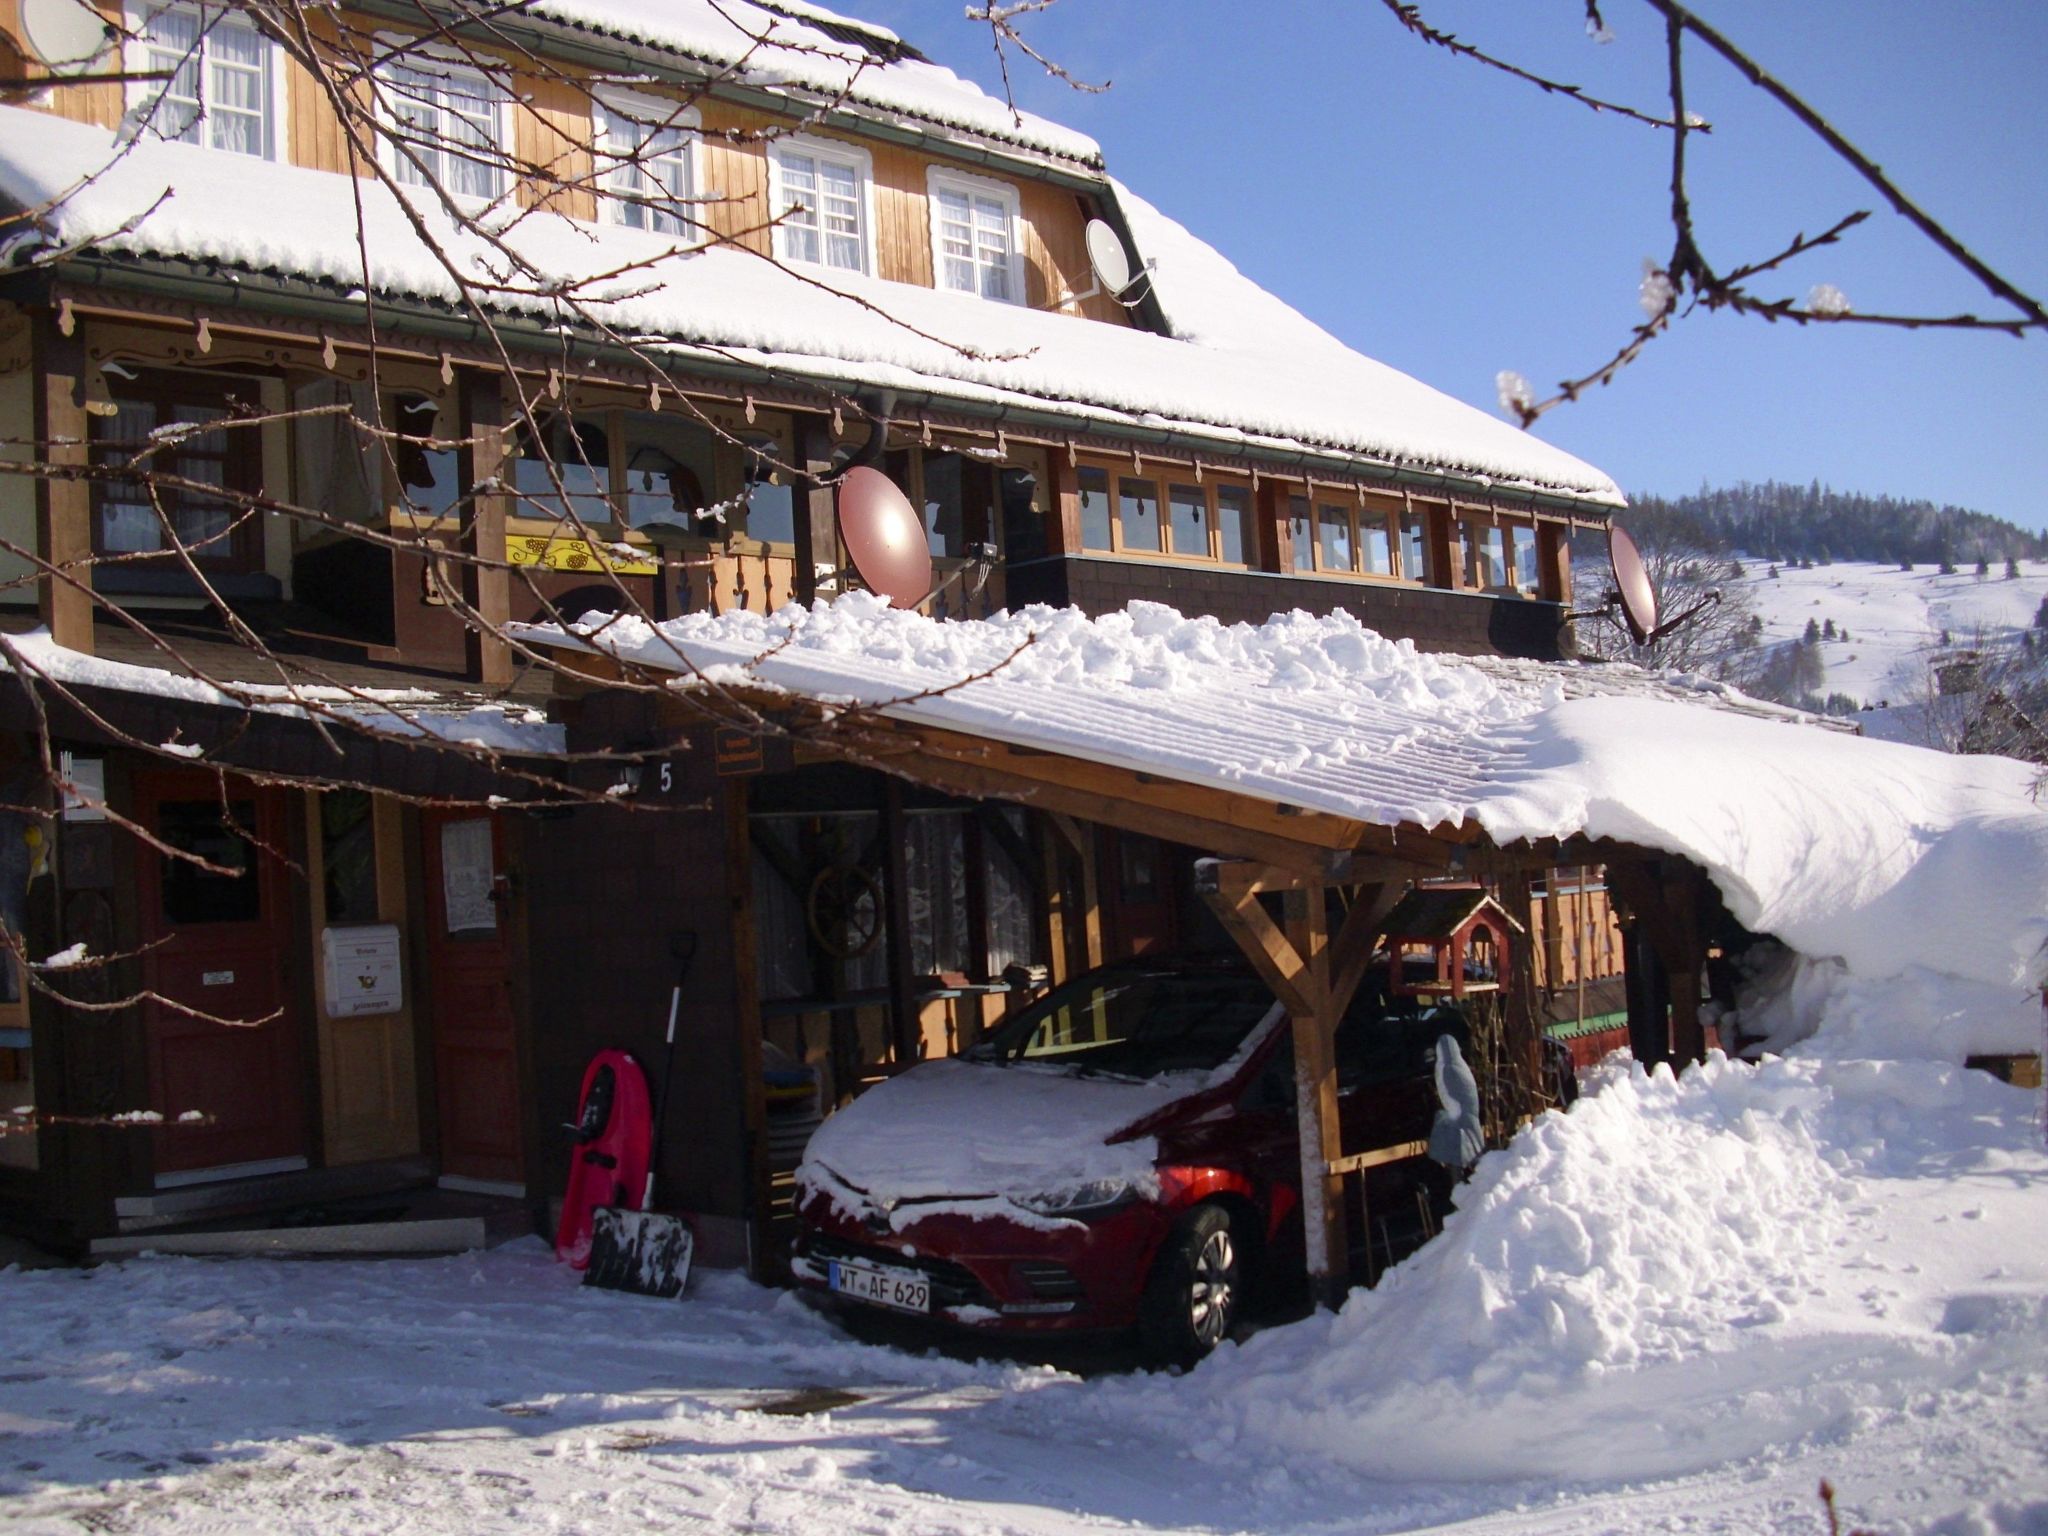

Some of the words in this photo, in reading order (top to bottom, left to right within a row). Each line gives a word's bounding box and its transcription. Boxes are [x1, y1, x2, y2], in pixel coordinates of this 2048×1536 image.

[660, 762, 672, 792] 5
[838, 1265, 858, 1290] WT
[868, 1276, 889, 1299] AF
[894, 1281, 927, 1308] 629
